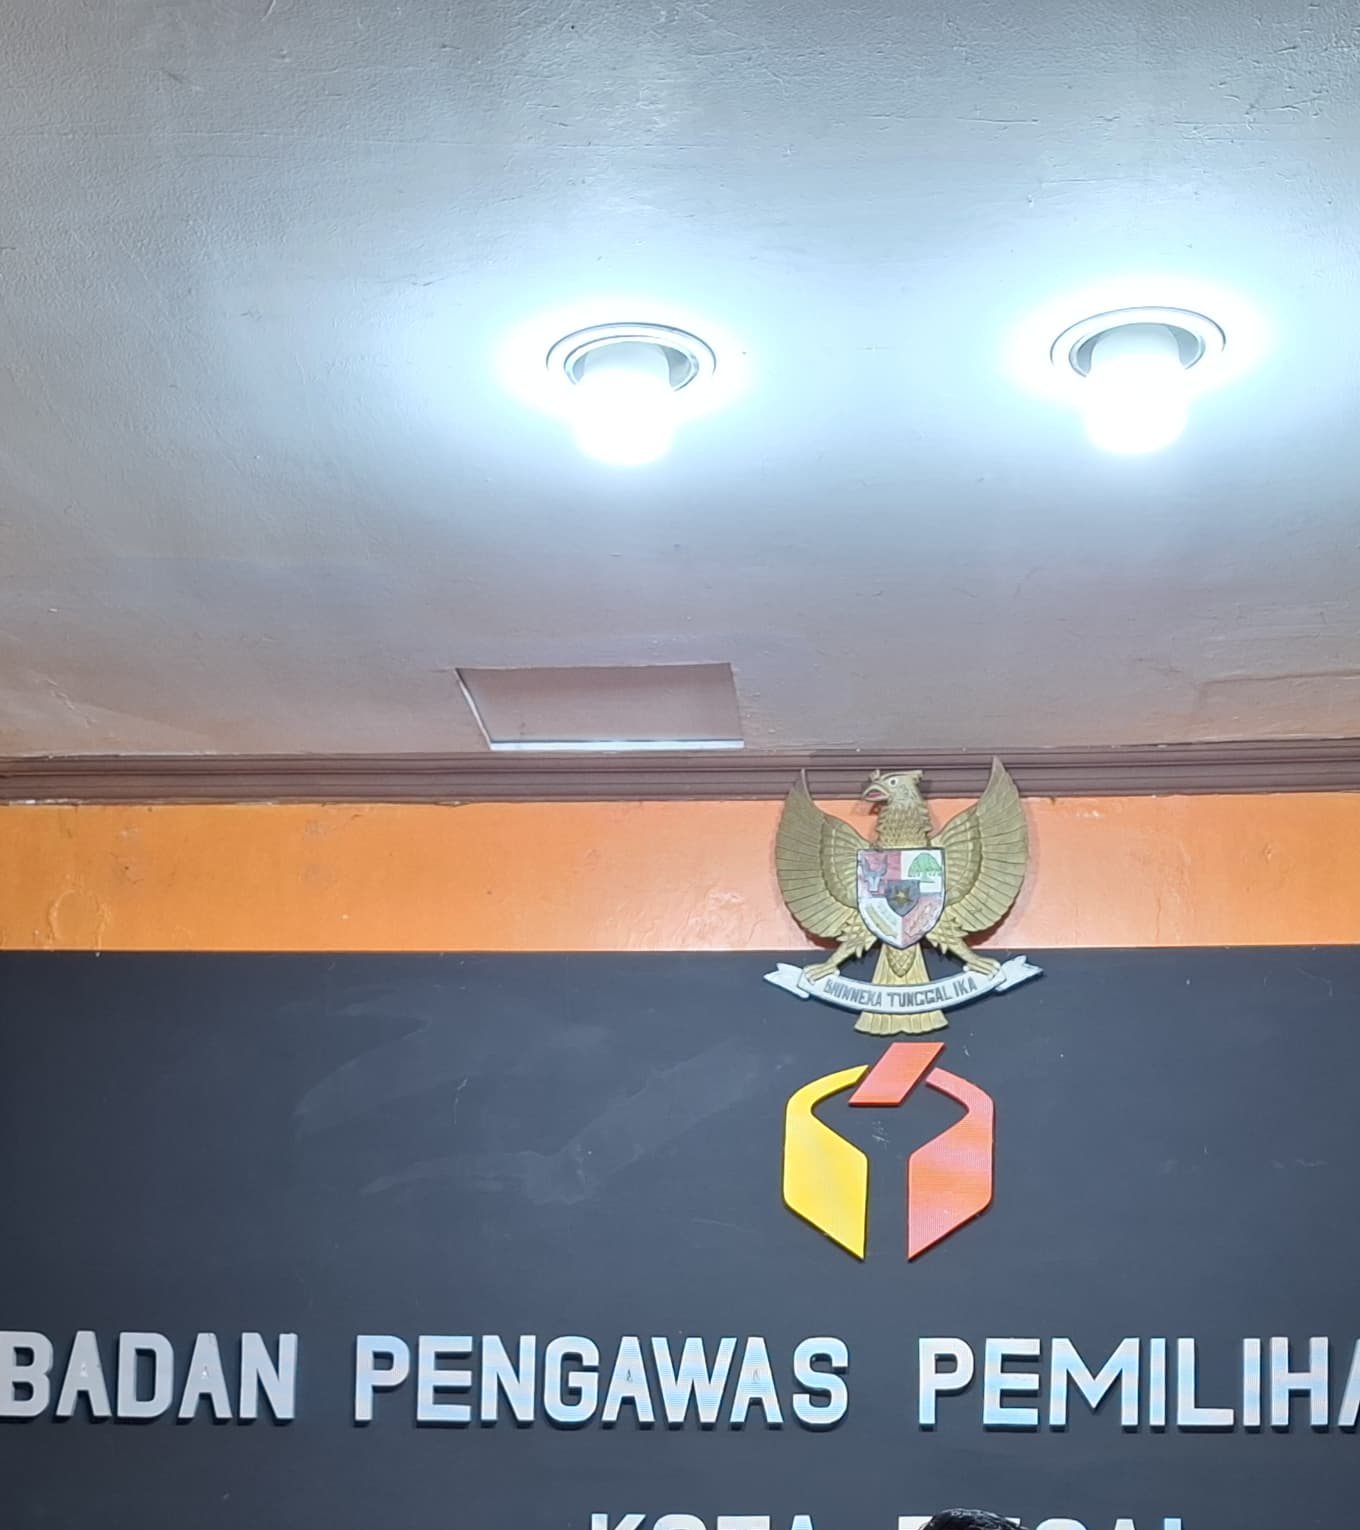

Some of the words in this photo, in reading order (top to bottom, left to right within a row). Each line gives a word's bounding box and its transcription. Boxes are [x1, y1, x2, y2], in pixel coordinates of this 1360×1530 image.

[887, 988, 952, 1007] TUNGGAL
[953, 976, 977, 998] IKA
[354, 1334, 850, 1426] PENGAWAS
